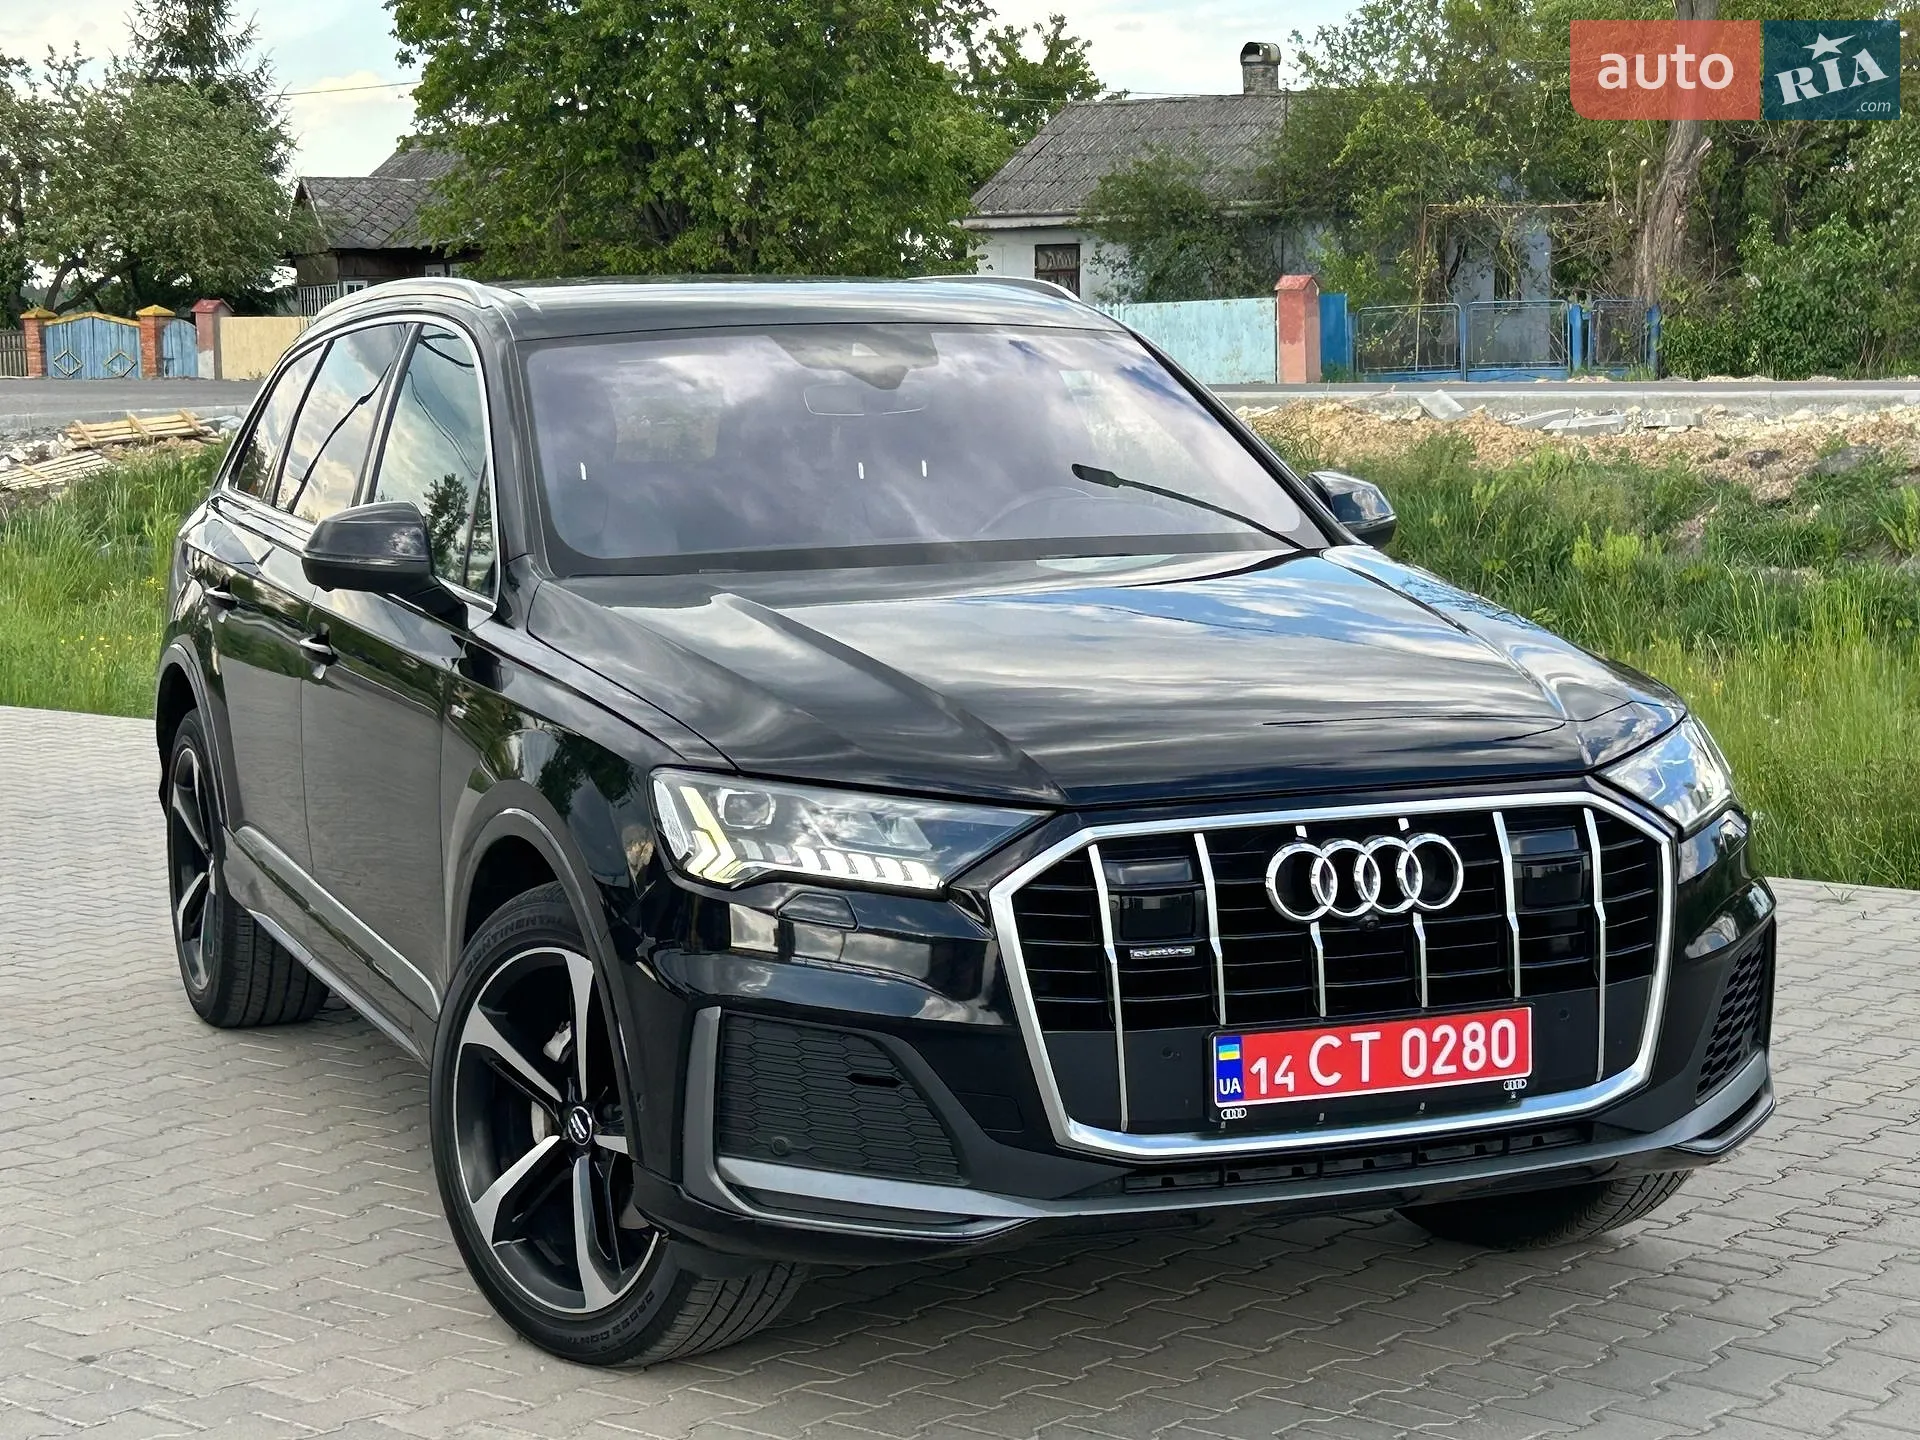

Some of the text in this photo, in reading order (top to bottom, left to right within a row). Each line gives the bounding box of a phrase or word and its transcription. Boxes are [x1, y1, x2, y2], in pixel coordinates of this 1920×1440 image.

[1132, 946, 1193, 958] quattro
[1250, 1018, 1517, 1095] 14 CT 0280
[1219, 1077, 1242, 1096] UA
